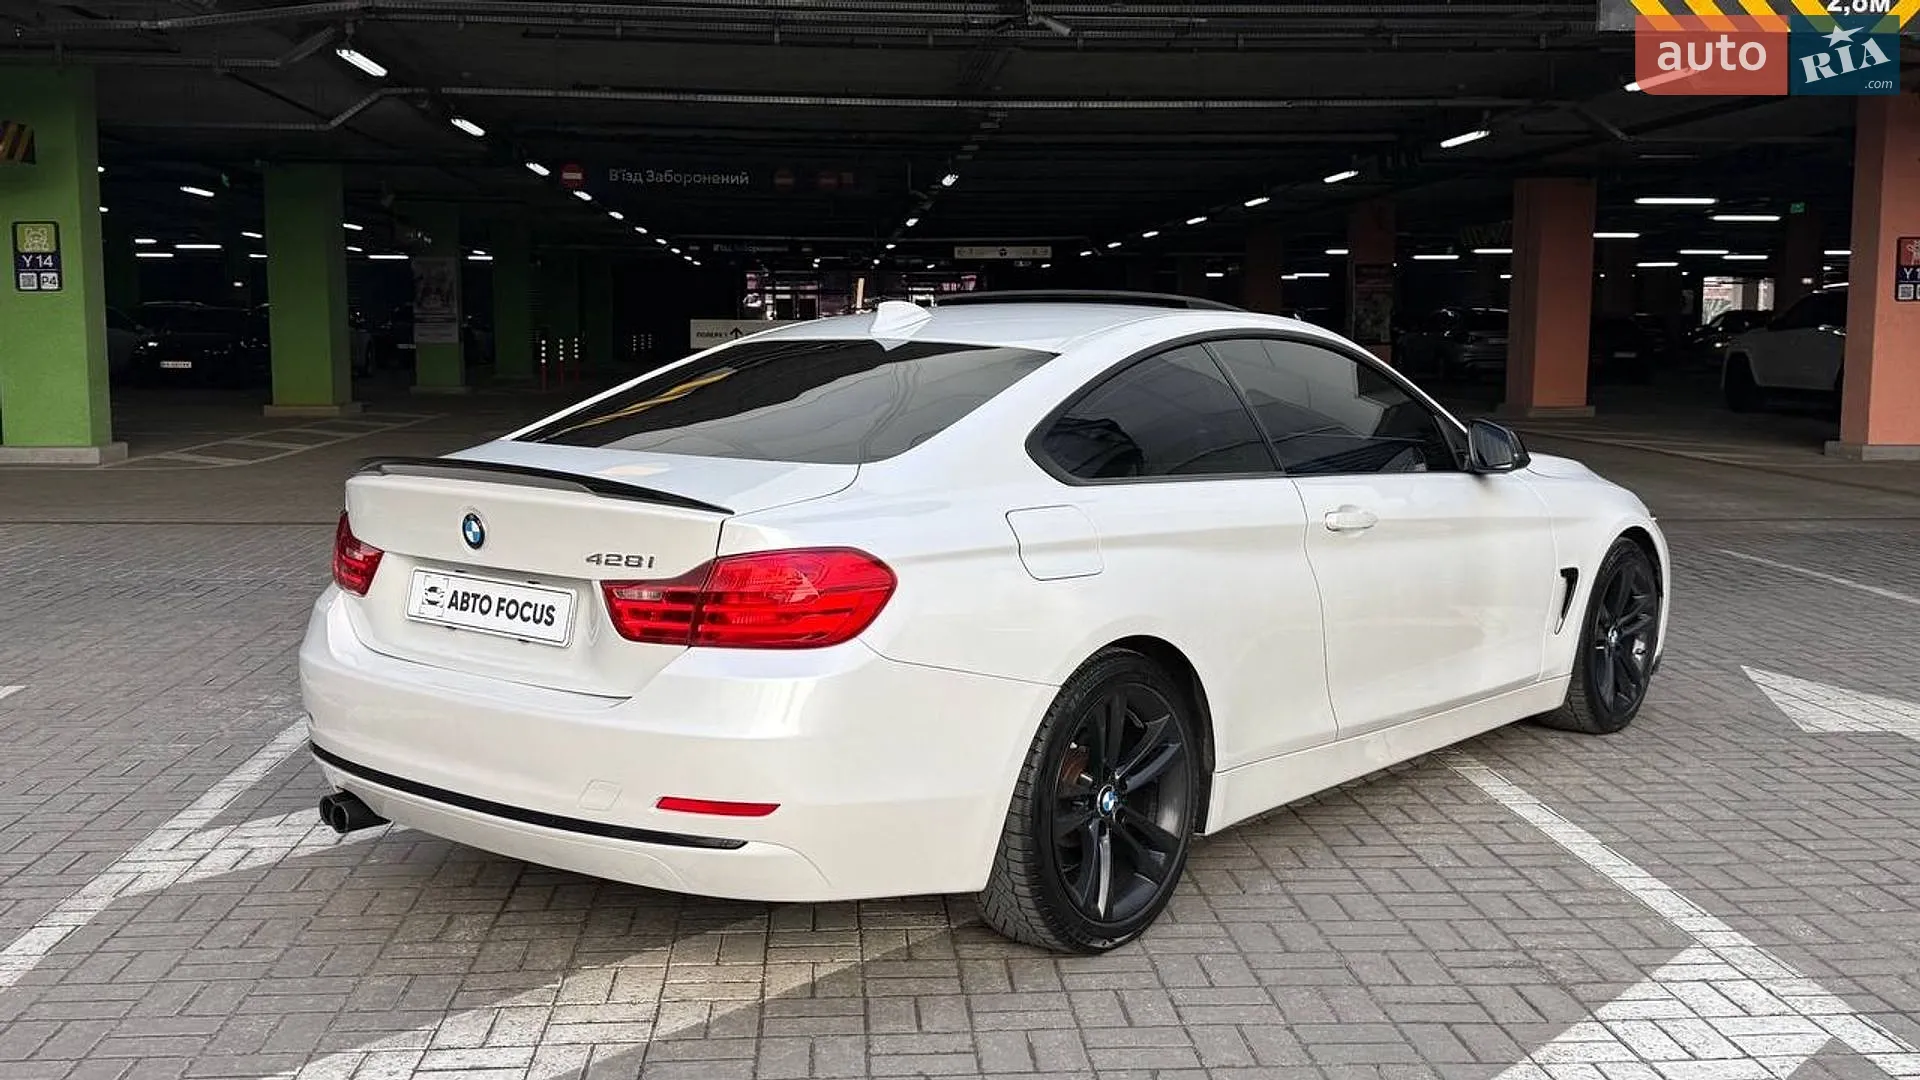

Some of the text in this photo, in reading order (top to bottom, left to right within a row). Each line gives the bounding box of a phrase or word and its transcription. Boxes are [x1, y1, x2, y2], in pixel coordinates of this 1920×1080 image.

[646, 169, 749, 187] Заборонений
[22, 255, 53, 268] Y 14
[1904, 268, 1913, 279] Y
[42, 276, 56, 285] P4
[447, 589, 556, 626] АВТО FOCUS
